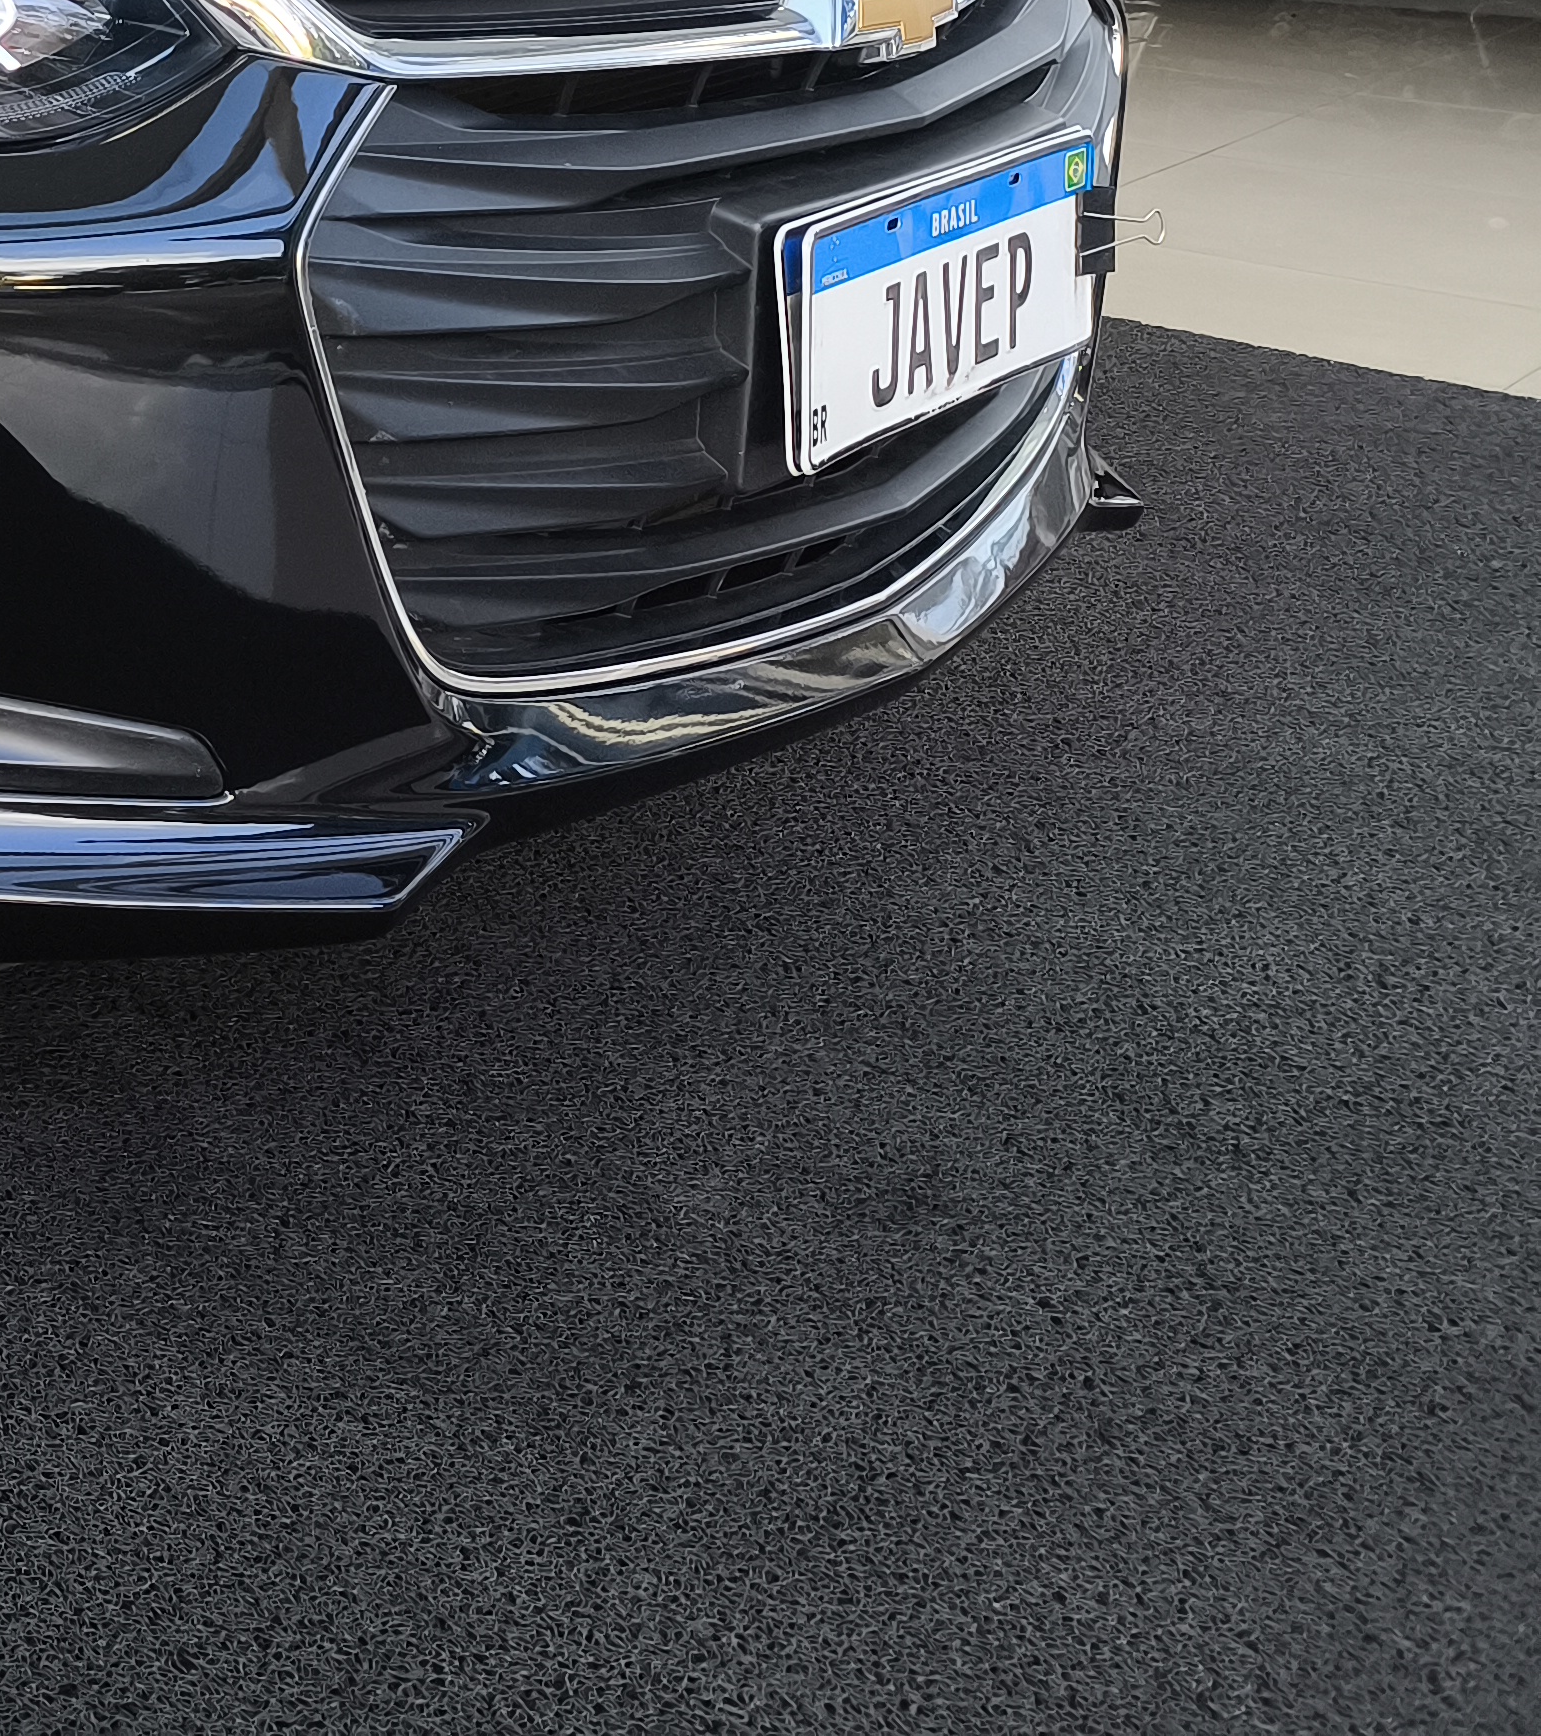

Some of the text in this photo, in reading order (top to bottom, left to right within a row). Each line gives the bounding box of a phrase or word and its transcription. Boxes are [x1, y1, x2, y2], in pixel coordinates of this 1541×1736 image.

[931, 199, 979, 238] BRASIL
[871, 231, 1033, 408] JAVEP
[812, 404, 828, 448] BR
